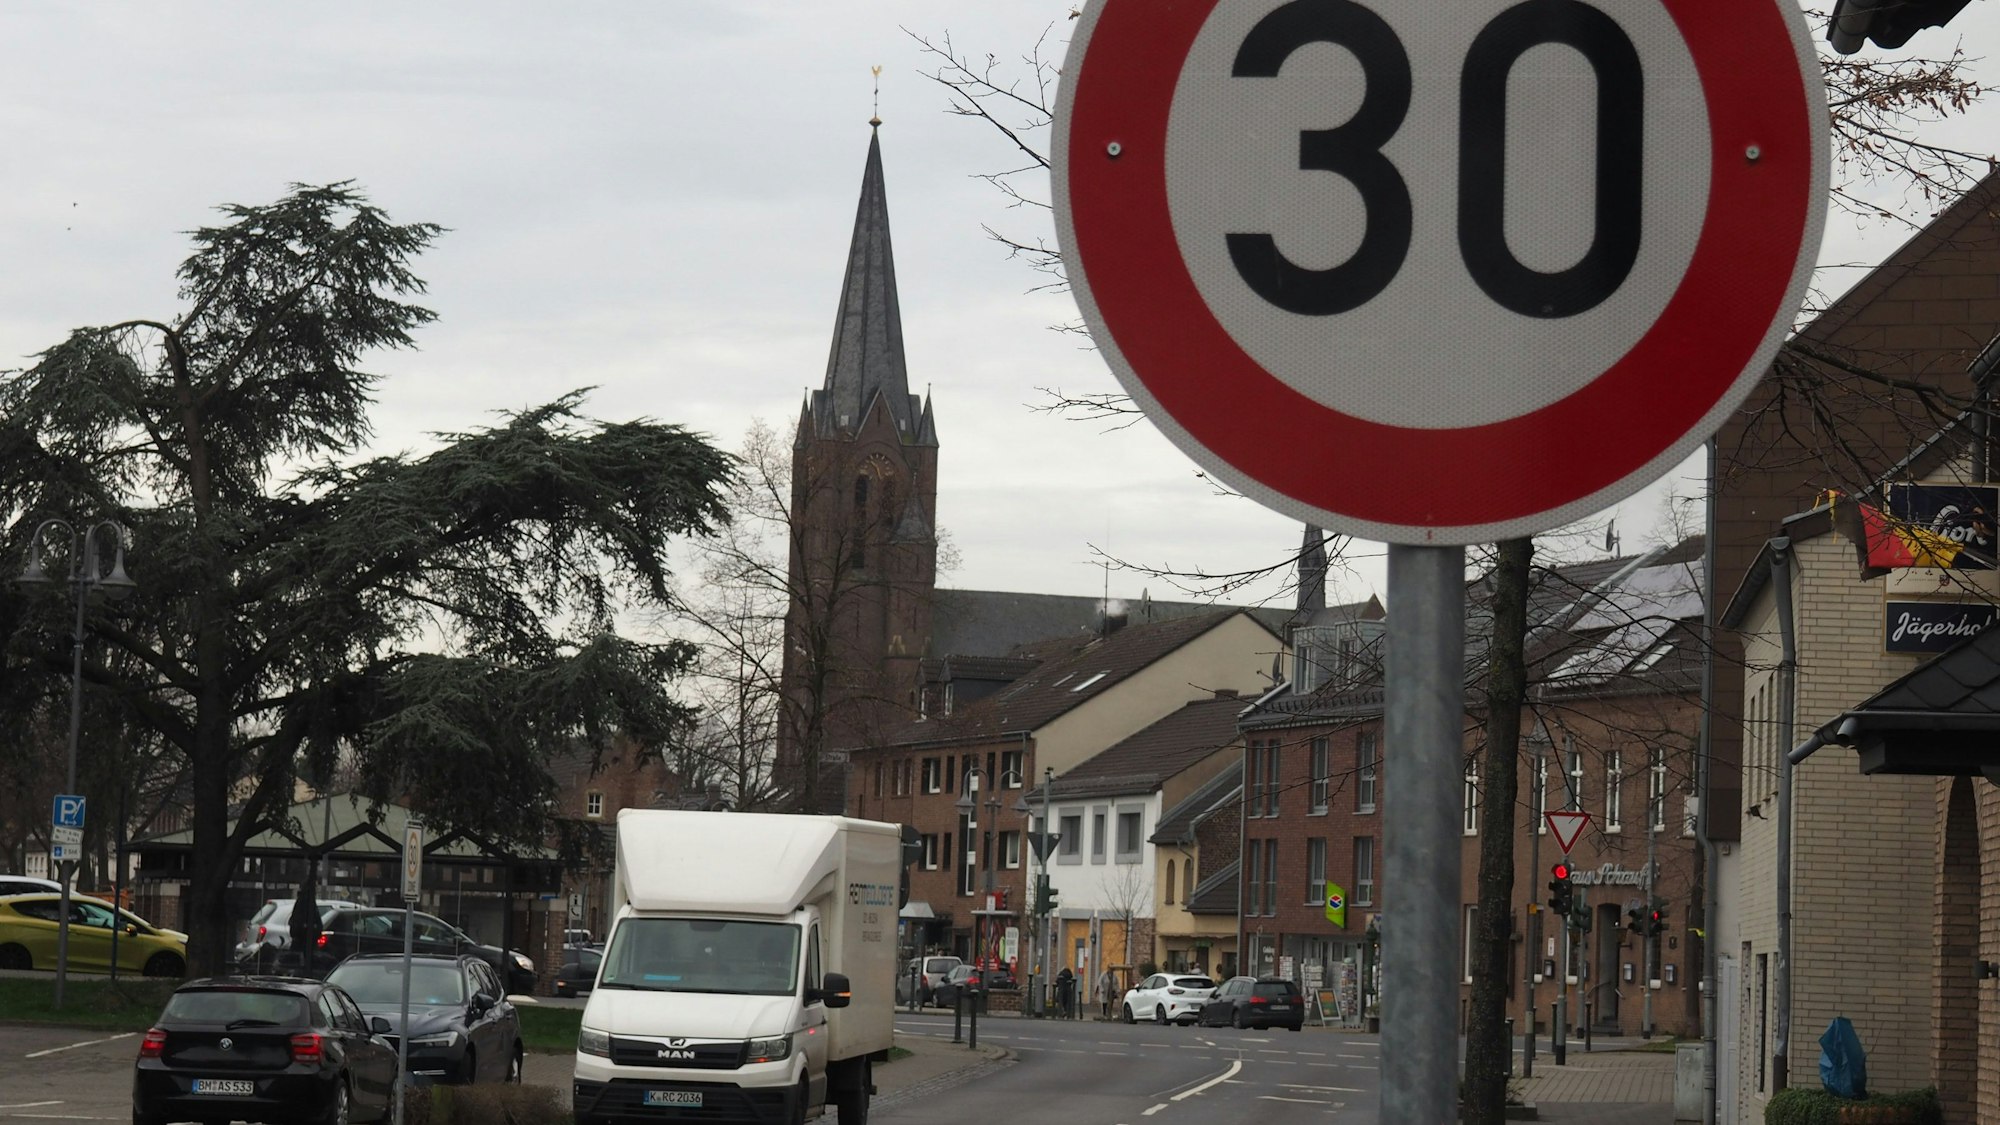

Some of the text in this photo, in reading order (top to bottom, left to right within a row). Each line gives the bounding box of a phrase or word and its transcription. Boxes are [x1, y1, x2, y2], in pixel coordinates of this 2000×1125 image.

[1226, 0, 1644, 319] 30
[1891, 611, 1992, 644] Jägerho
[657, 1049, 696, 1059] MAN
[198, 1080, 252, 1093] BM AS 533
[650, 1092, 701, 1104] K RC 2036
